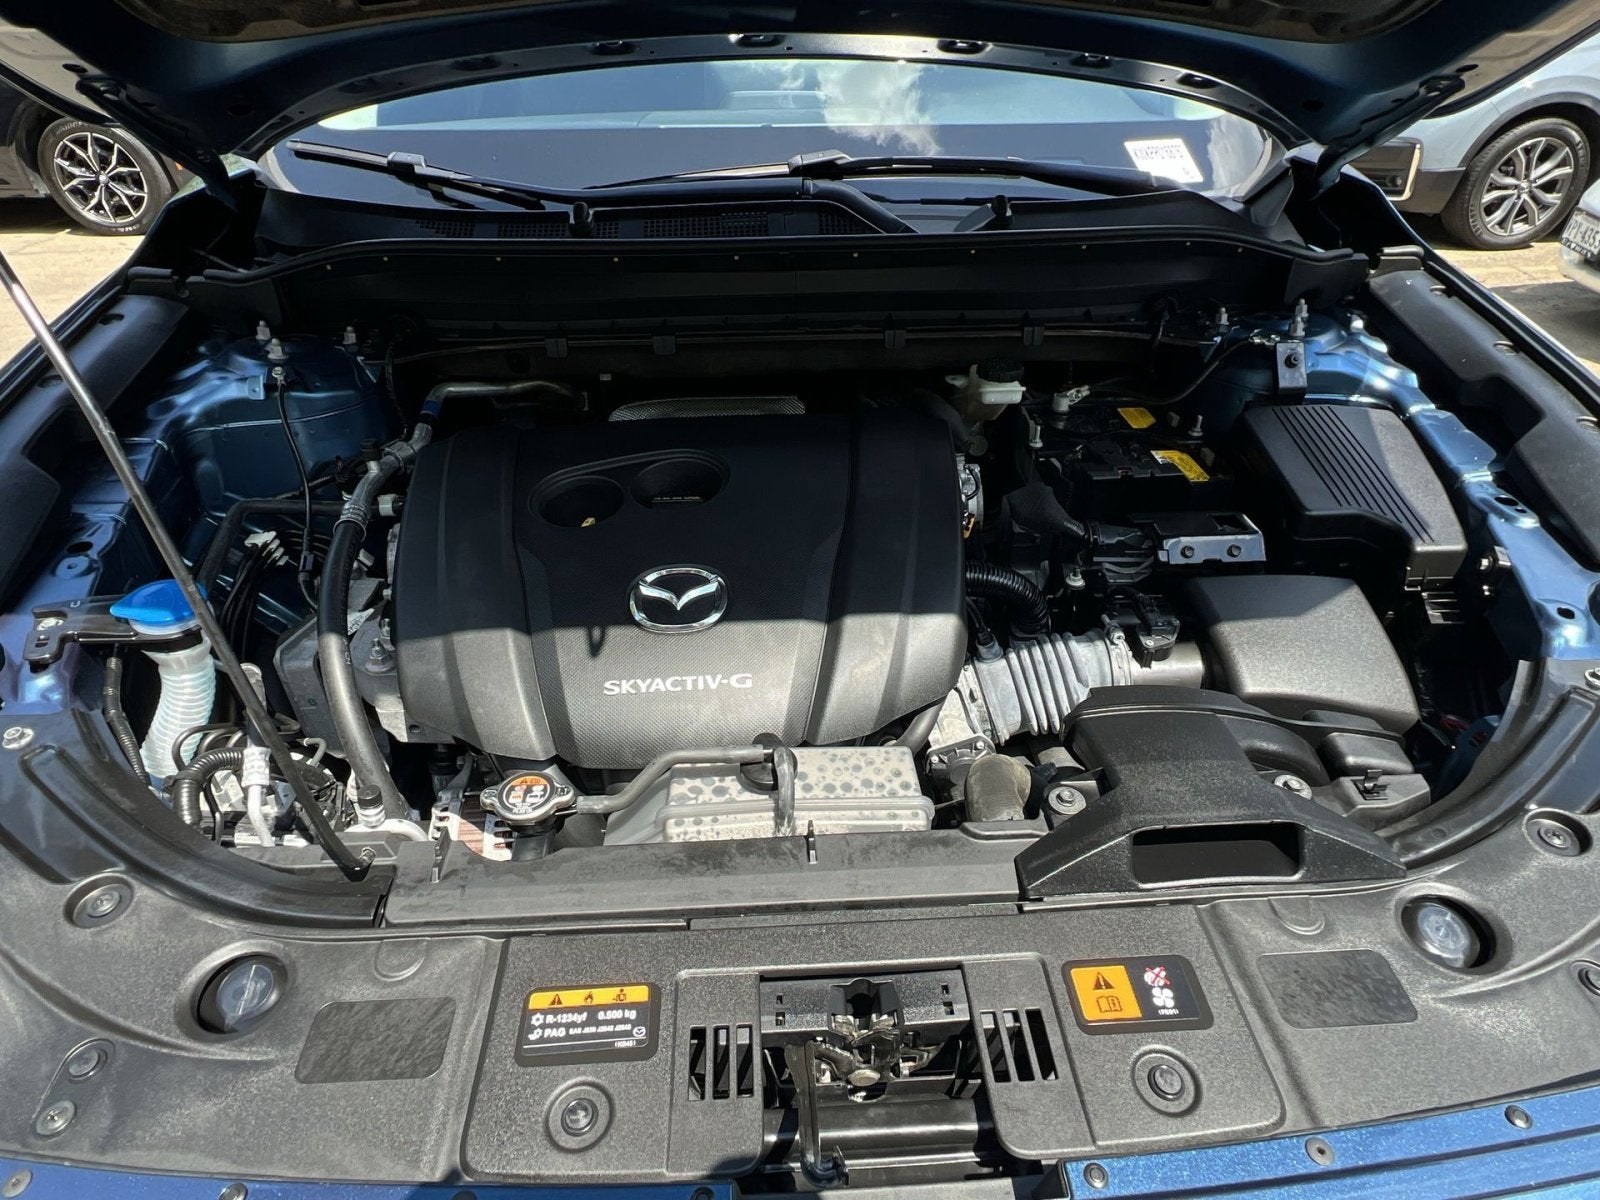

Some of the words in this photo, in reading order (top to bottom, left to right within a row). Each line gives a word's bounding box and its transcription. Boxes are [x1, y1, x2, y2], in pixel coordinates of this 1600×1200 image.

[603, 672, 753, 696] SKYACTIV-G
[546, 1012, 587, 1024] R-1234yf
[598, 1010, 623, 1020] 0.500
[624, 1008, 637, 1020] kg
[543, 1027, 566, 1038] PAG
